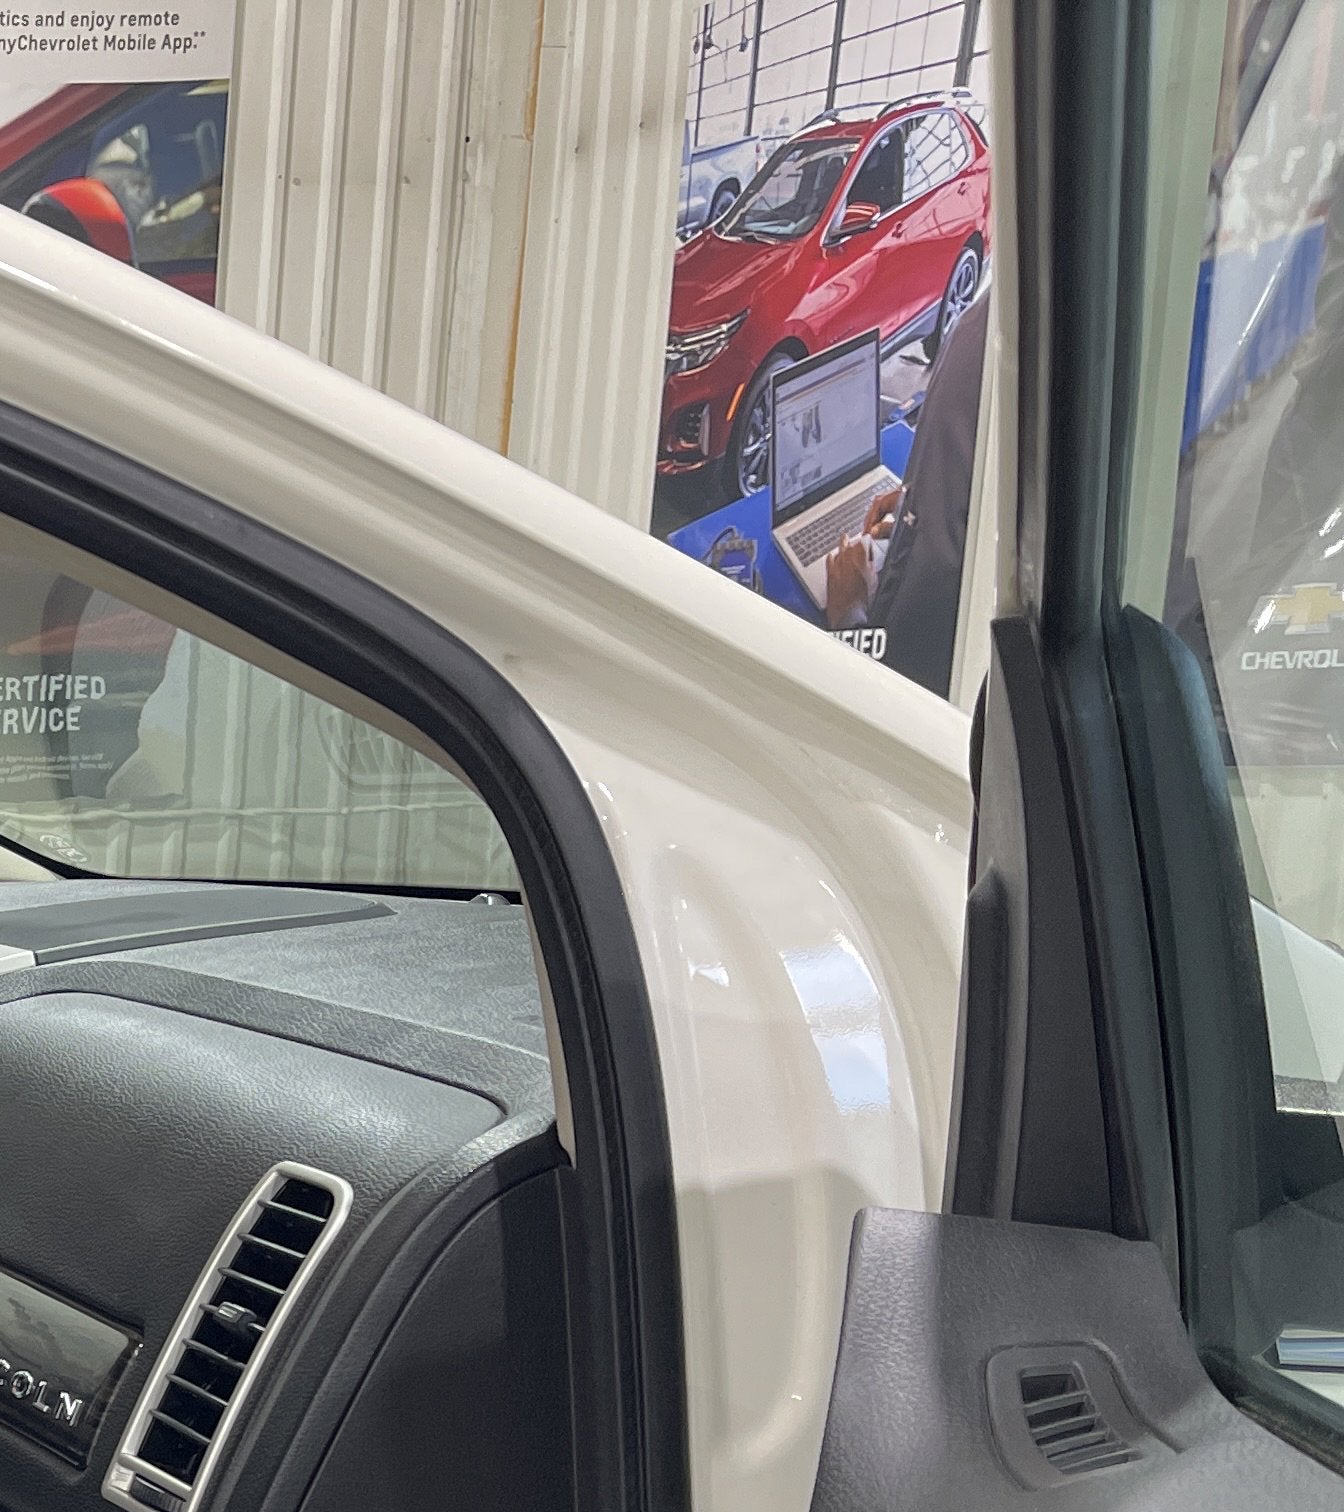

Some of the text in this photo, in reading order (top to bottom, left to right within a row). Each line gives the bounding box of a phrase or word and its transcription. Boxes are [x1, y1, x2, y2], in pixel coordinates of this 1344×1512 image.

[35, 10, 65, 27] and
[70, 11, 115, 32] enjoy
[120, 10, 180, 27] remote
[103, 33, 157, 51] Mobile
